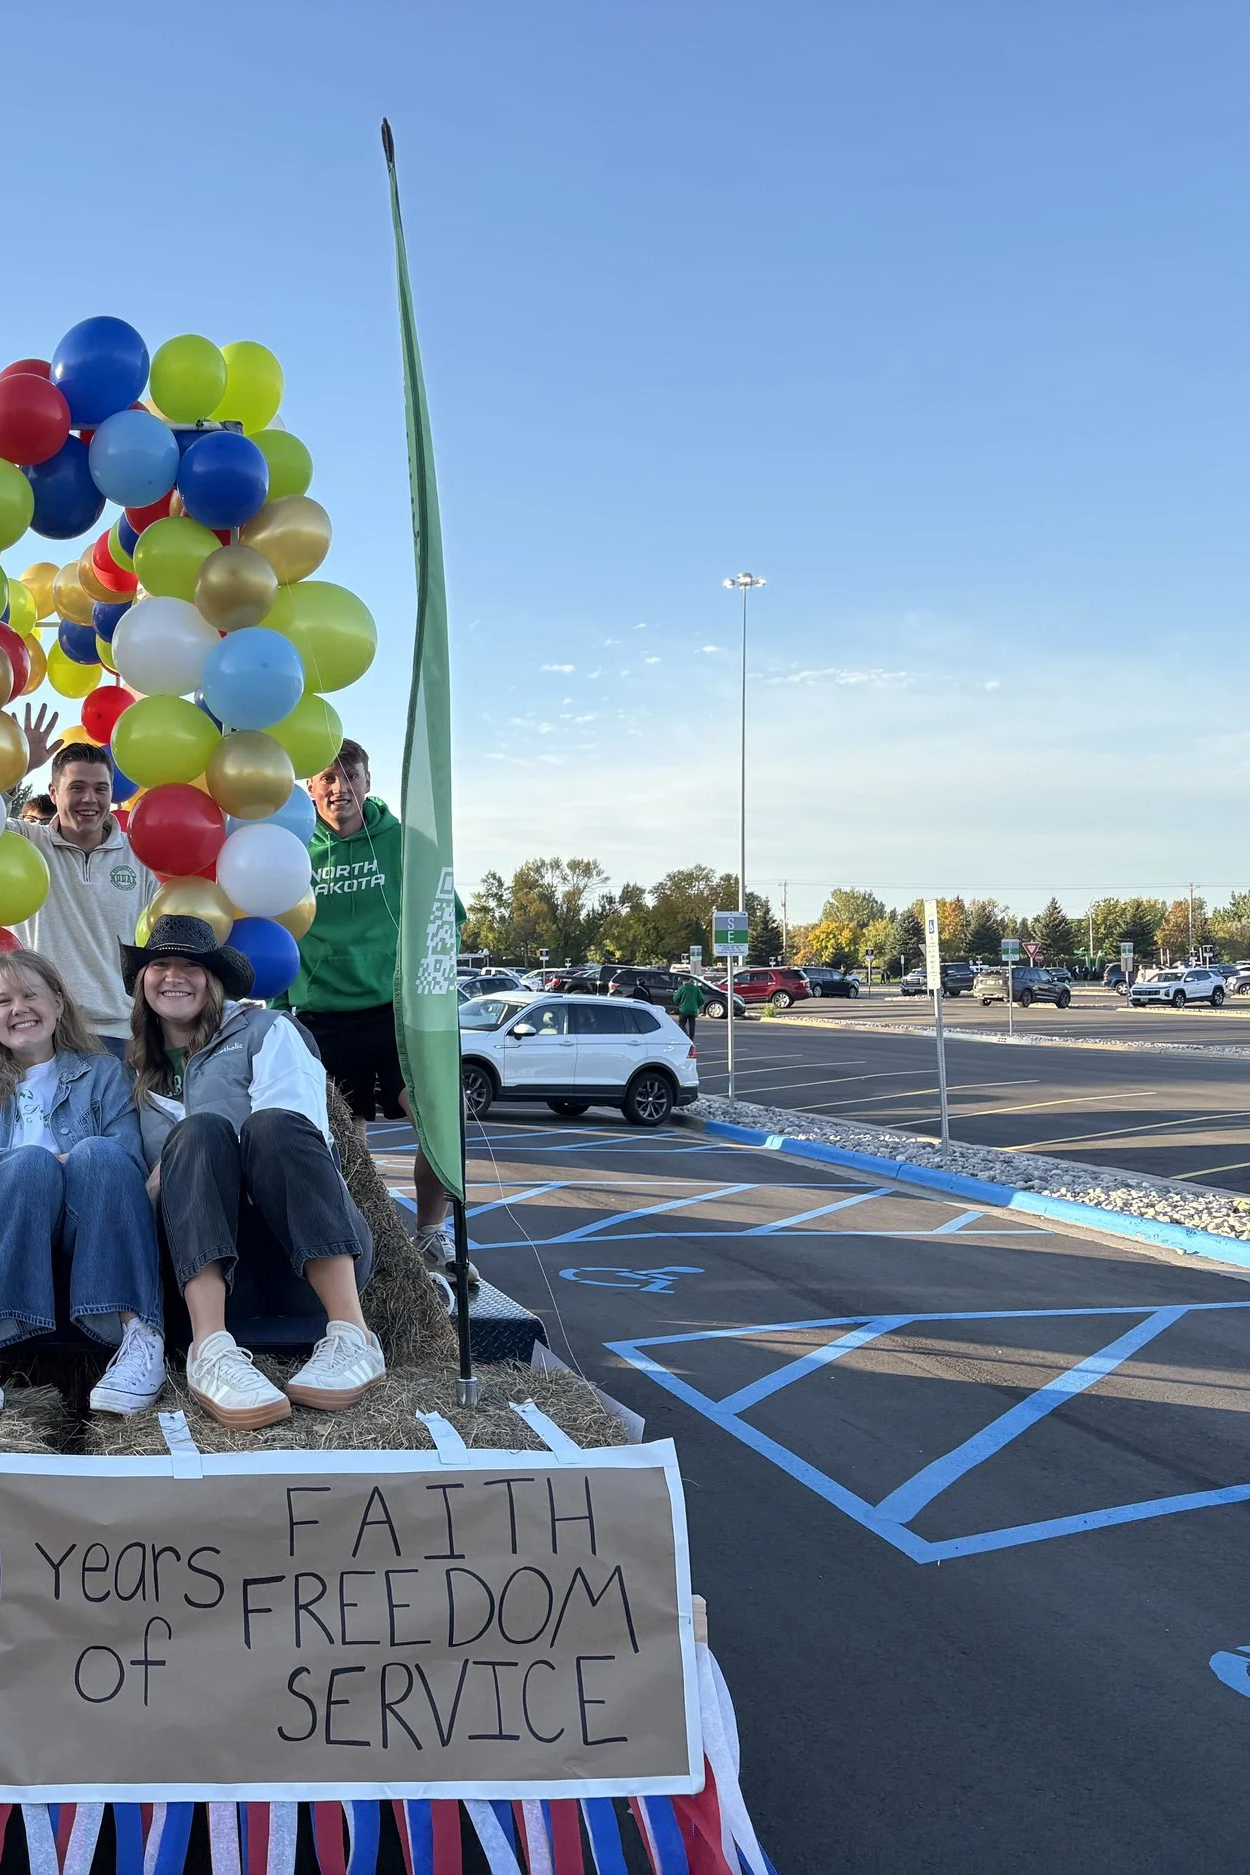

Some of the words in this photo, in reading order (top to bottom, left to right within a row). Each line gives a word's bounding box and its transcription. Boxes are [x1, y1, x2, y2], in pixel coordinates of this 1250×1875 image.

[312, 860, 377, 882] NORTH
[315, 874, 385, 896] AKOTA
[727, 917, 735, 930] S
[727, 931, 735, 943] E
[286, 1475, 597, 1559] FAITH
[242, 1565, 640, 1655] FREEDOM
[278, 1655, 629, 1751] SERVICE
